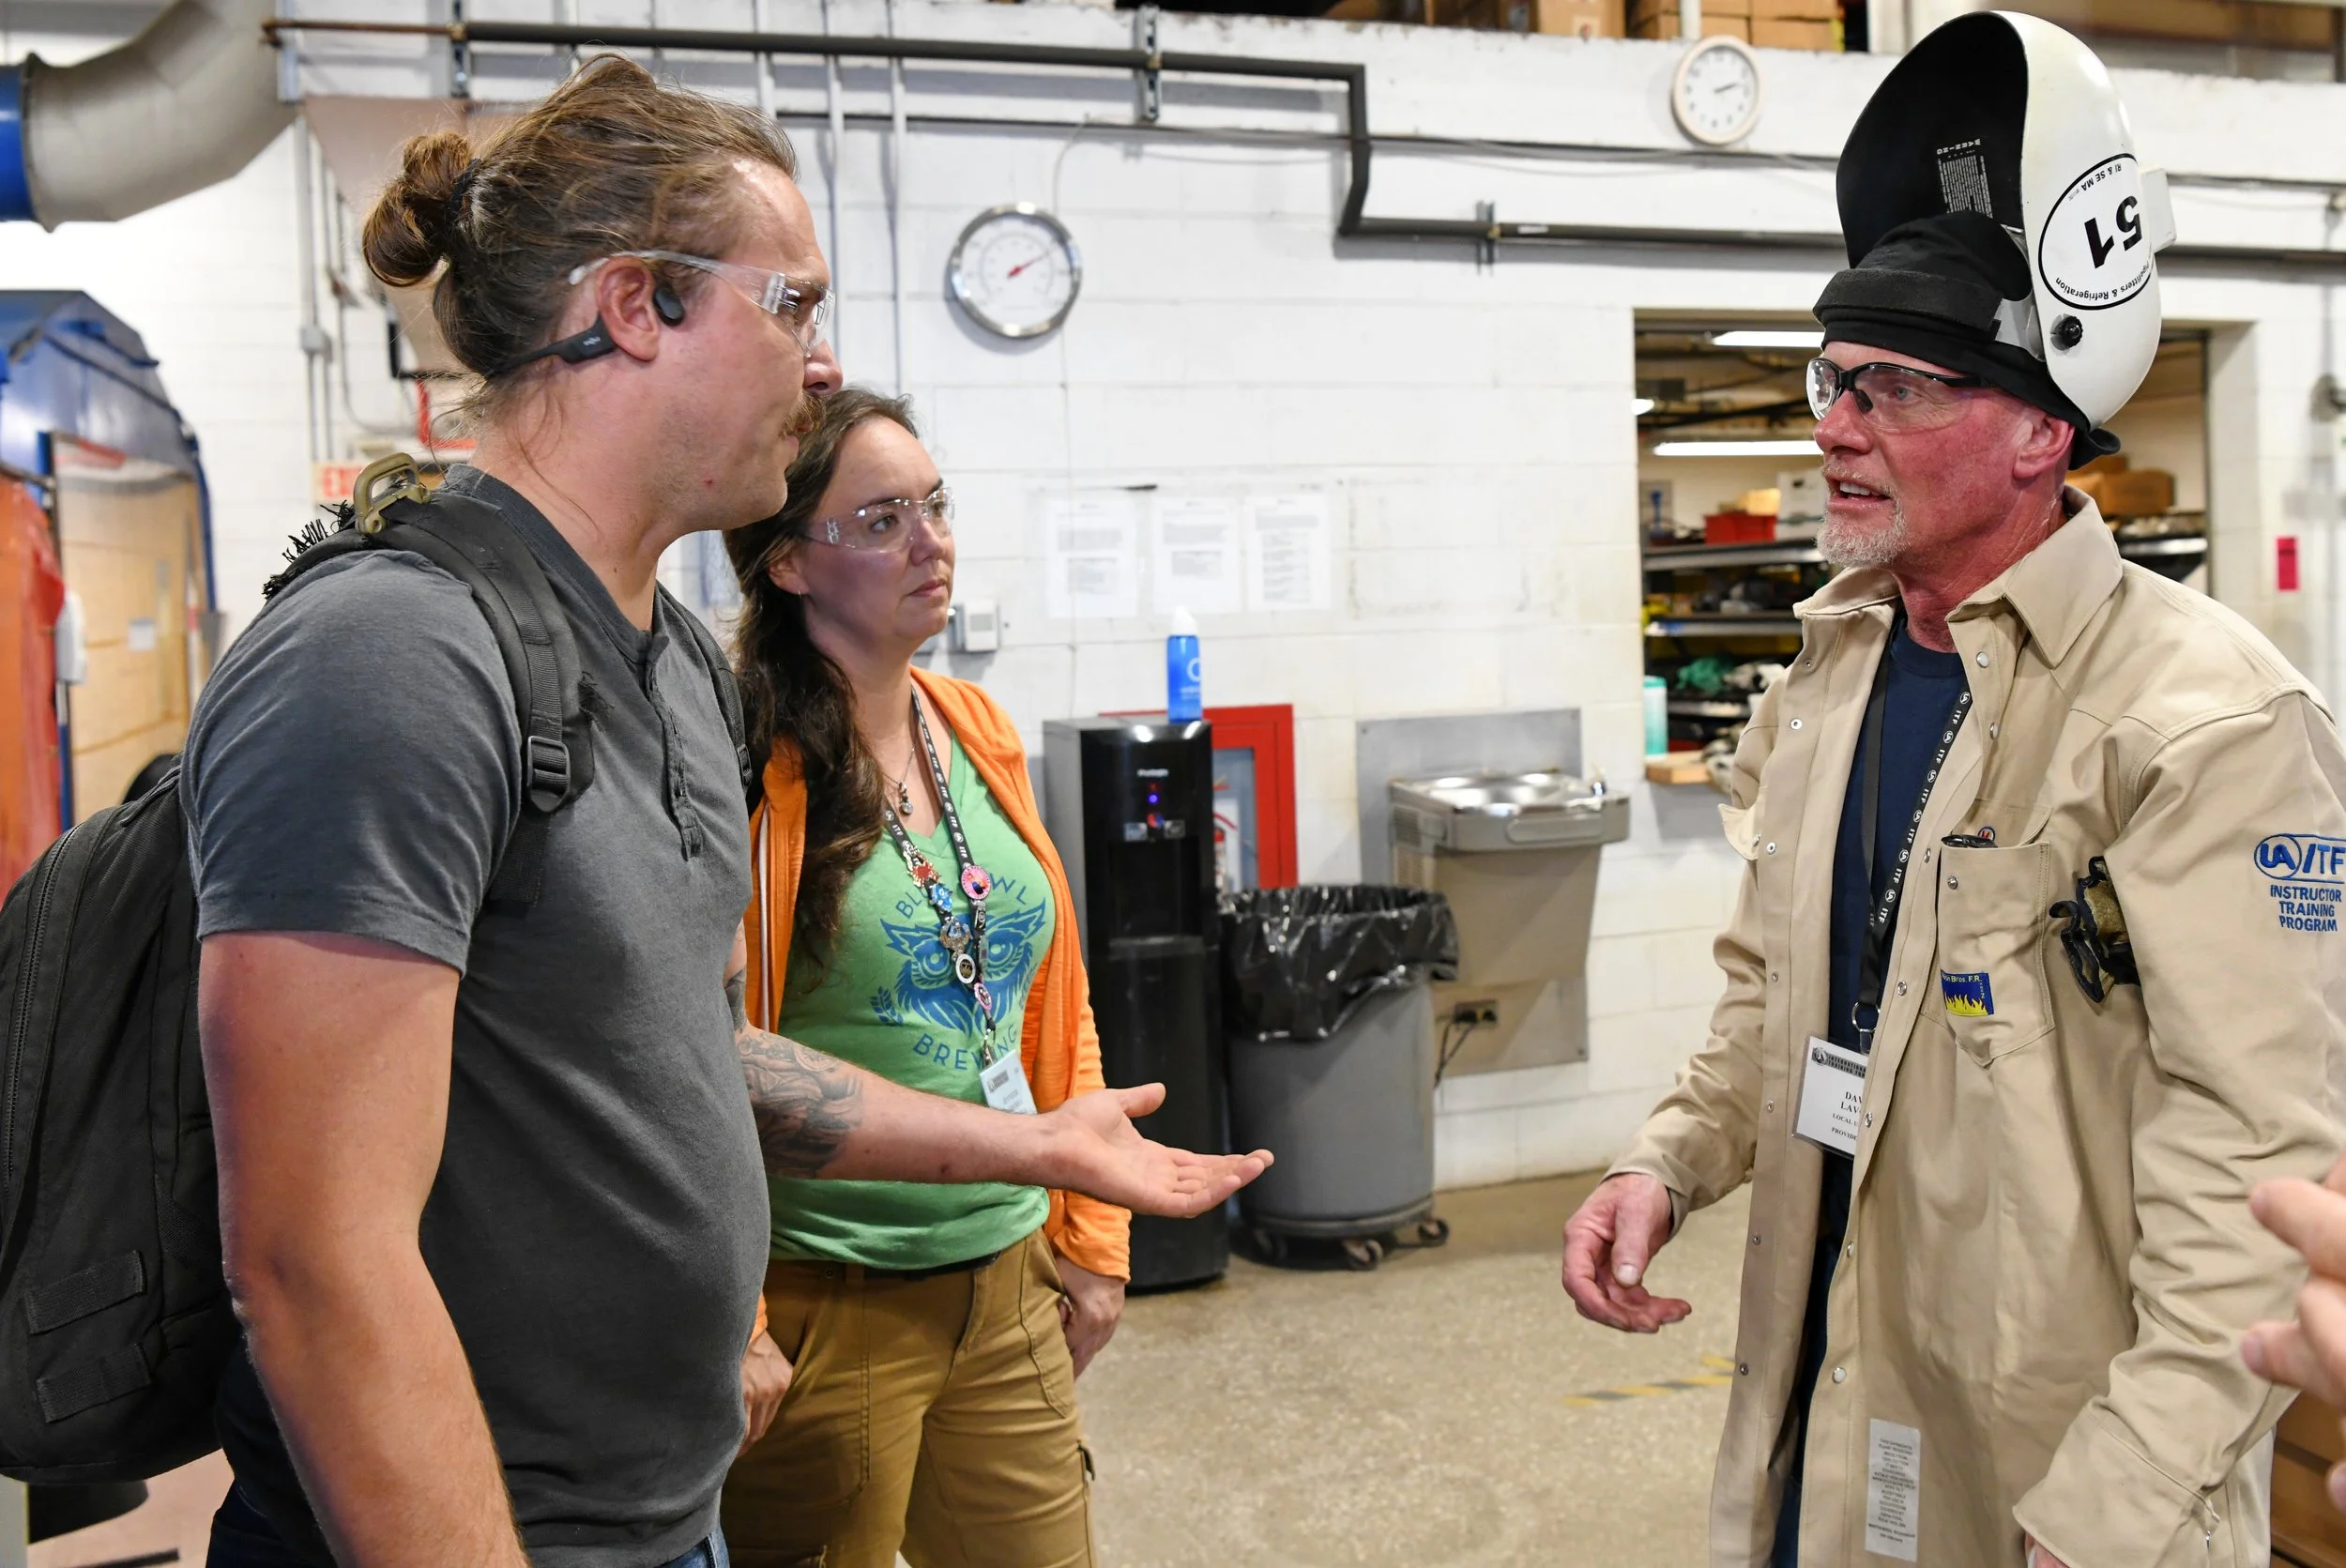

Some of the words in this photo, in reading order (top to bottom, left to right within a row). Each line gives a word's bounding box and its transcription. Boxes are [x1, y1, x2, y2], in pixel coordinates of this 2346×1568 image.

[2095, 171, 2106, 182] SE
[2108, 167, 2113, 175] &
[2080, 177, 2095, 191] MA
[2083, 195, 2142, 269] 51
[2055, 277, 2110, 300] Refrigeration
[2111, 288, 2118, 297] &
[1953, 709, 1962, 724] ITF
[1936, 749, 1945, 764] ITF
[1921, 788, 1929, 803] ITF
[1907, 829, 1915, 844] ITF
[1893, 868, 1902, 883] ITF
[895, 888, 929, 919] BLU
[990, 873, 1027, 906] WL
[2270, 885, 2342, 903] INSTRUCTOR
[1879, 907, 1888, 923] ITF
[2278, 901, 2336, 917] TRAINING
[2278, 916, 2338, 932] PROGRAM
[1827, 1054, 1866, 1073] INTERNATIONA
[1845, 1091, 1862, 1104] DAV
[1840, 1101, 1860, 1114] LAV
[1833, 1113, 1852, 1125] LOCAL
[1832, 1126, 1857, 1141] PROVIDE
